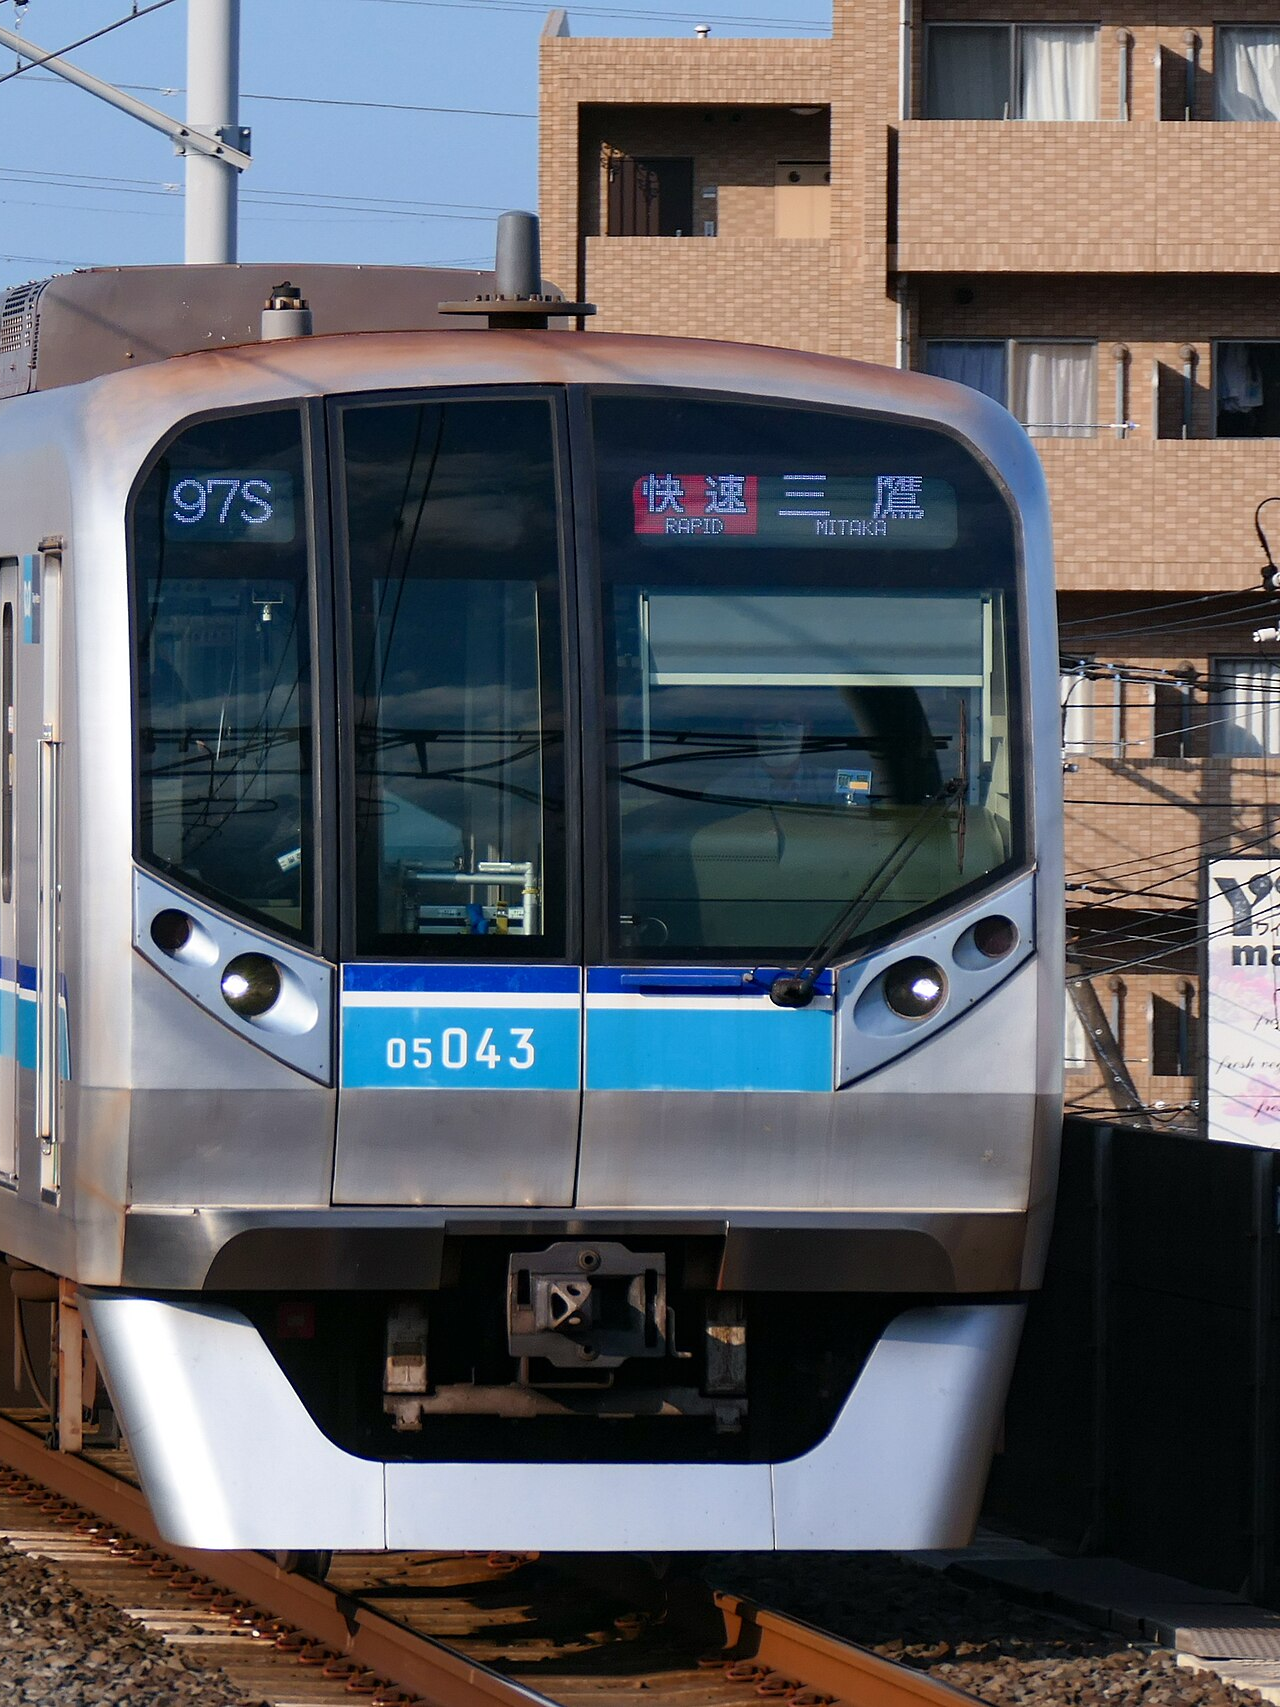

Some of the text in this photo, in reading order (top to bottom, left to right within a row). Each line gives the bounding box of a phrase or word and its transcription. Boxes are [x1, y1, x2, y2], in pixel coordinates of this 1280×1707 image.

[173, 479, 273, 523] 97S
[642, 473, 925, 519] 快速 三鷹
[665, 518, 888, 536] RAPID MITAKA
[1253, 1100, 1280, 1119] fre
